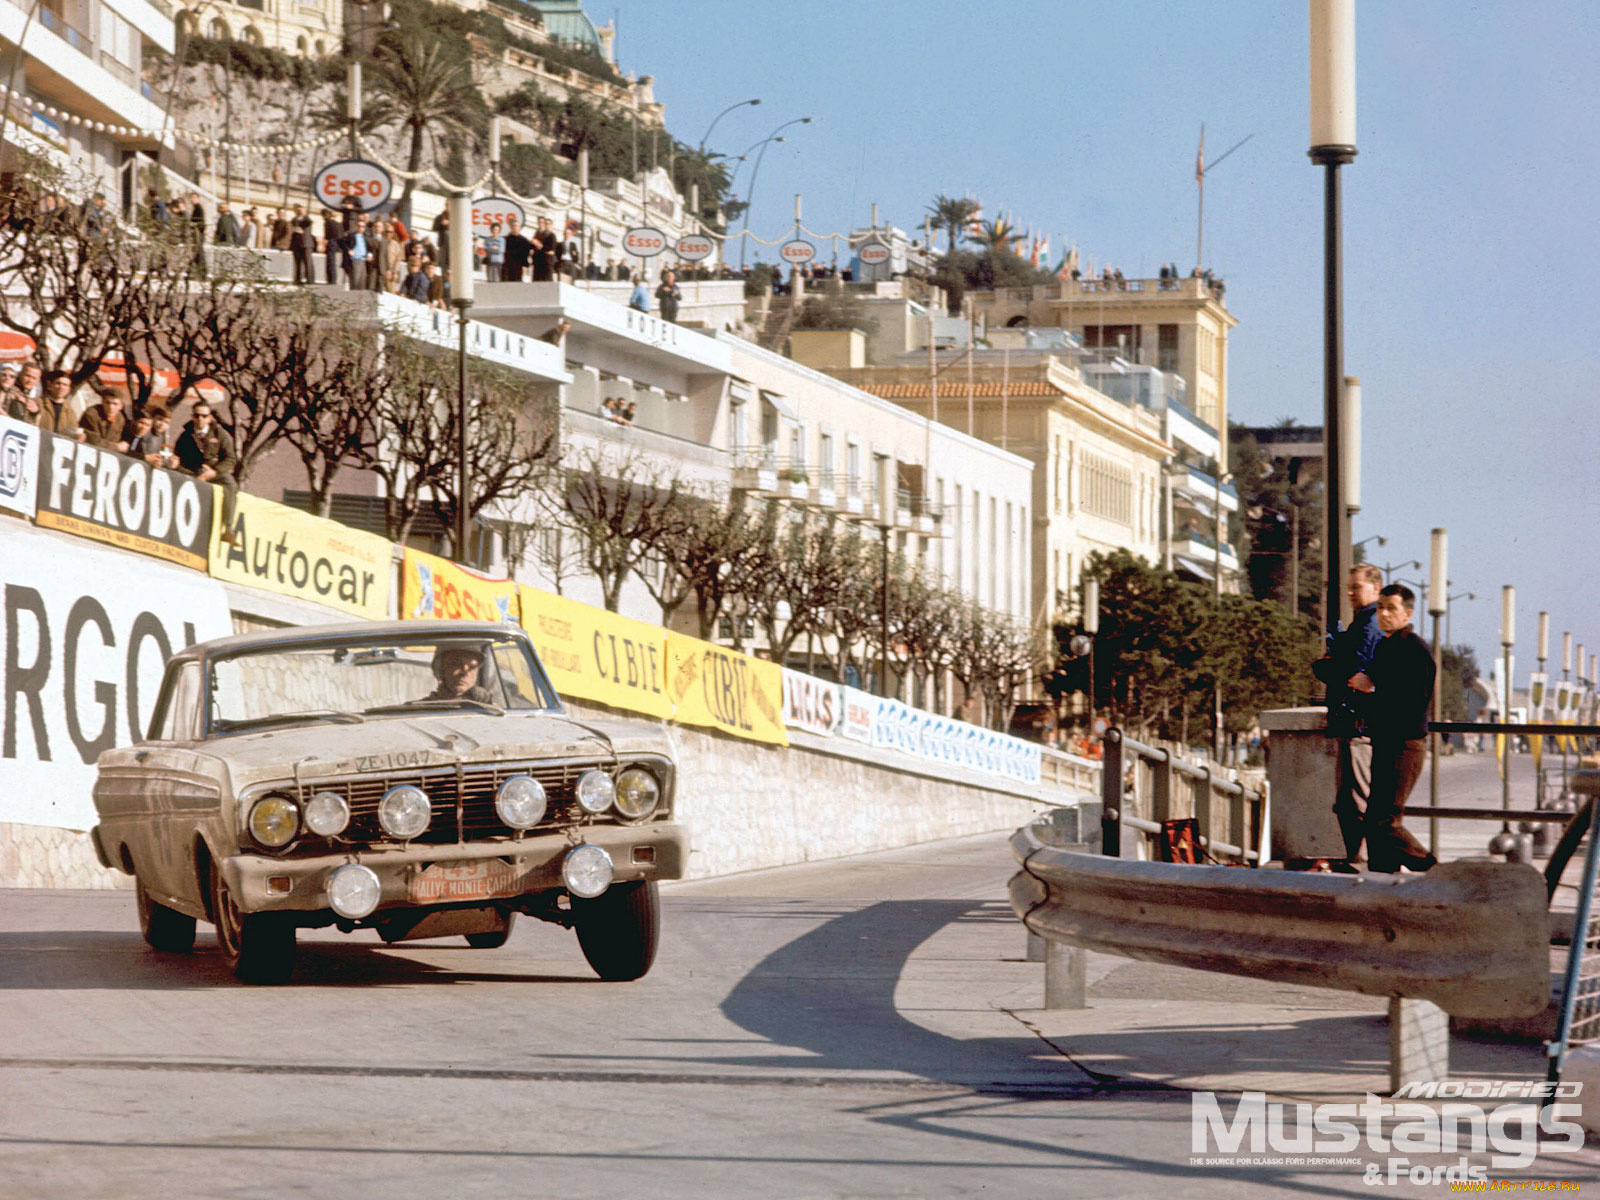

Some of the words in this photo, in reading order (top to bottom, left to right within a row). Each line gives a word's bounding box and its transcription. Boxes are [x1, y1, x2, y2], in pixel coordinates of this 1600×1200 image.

[323, 174, 383, 198] Esso
[471, 208, 518, 227] Esso
[626, 233, 663, 249] Esso
[678, 240, 710, 254] Esso
[783, 245, 813, 258] Esso
[860, 249, 888, 260] Esso
[627, 311, 678, 346] HOTEL
[49, 437, 200, 547] FERODO
[226, 511, 375, 606] Autocar
